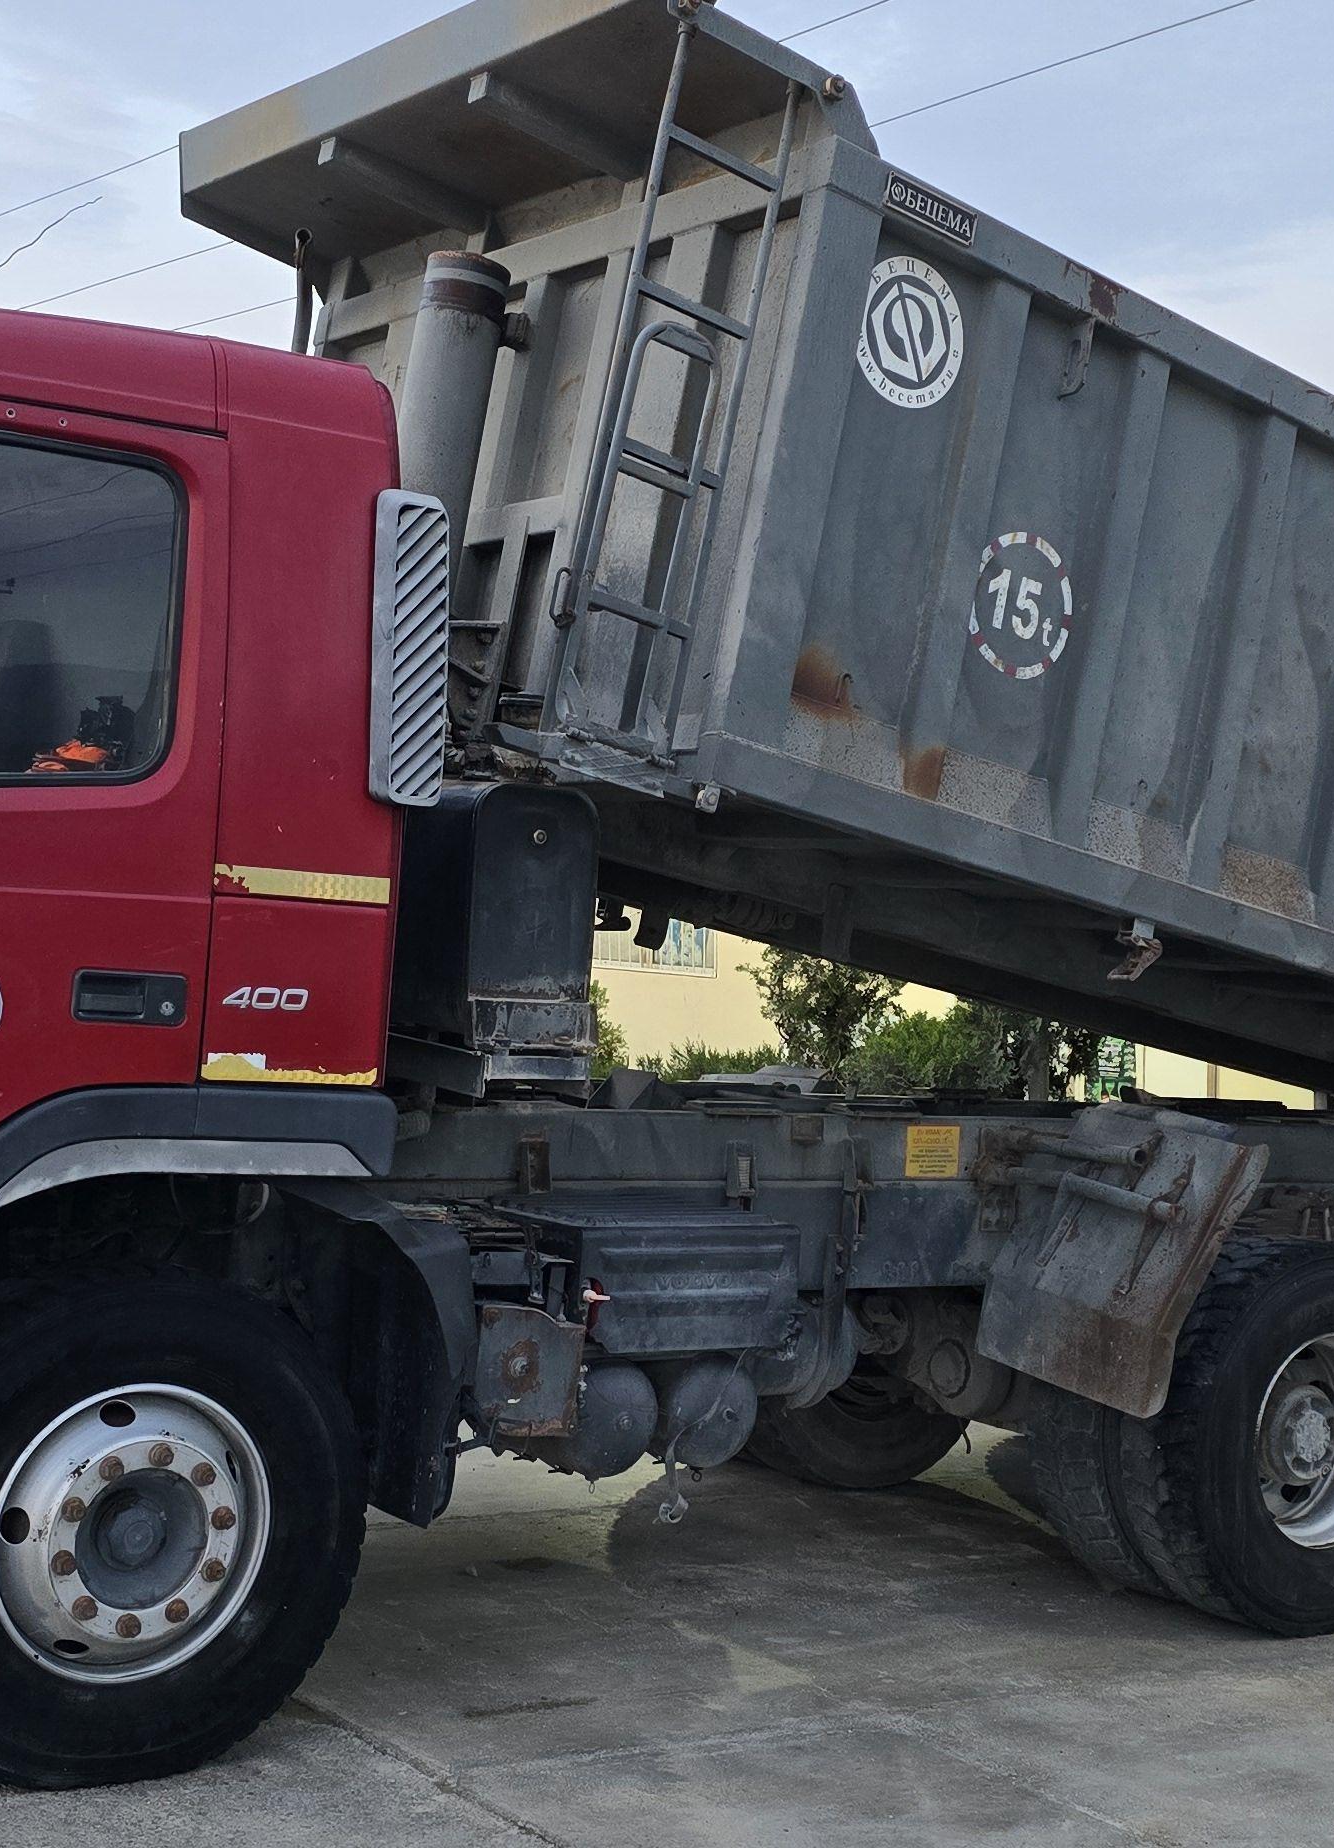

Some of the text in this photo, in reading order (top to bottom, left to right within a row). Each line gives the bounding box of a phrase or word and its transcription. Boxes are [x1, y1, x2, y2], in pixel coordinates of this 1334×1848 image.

[905, 188, 971, 238] БЕЦЕМА
[871, 259, 960, 323] БЕЦЕМА
[222, 986, 309, 1011] 400
